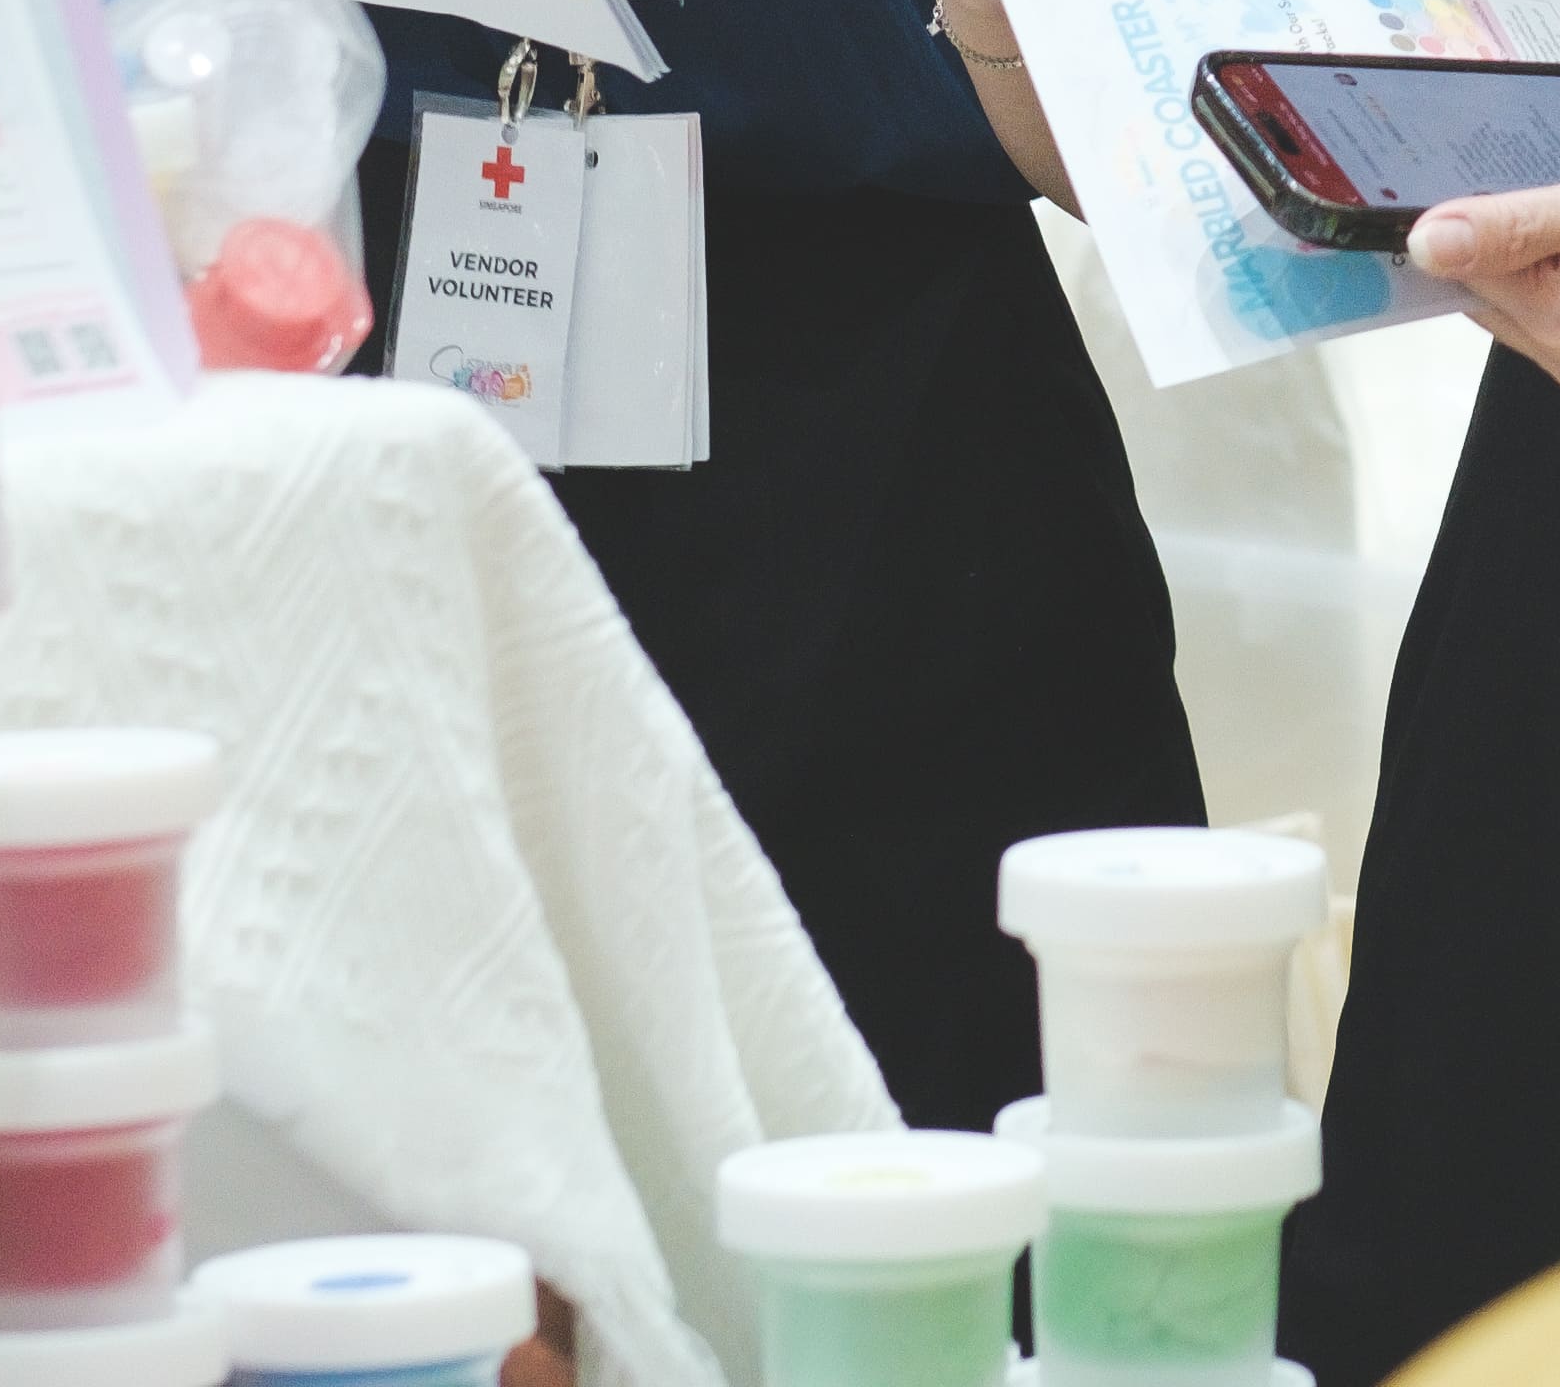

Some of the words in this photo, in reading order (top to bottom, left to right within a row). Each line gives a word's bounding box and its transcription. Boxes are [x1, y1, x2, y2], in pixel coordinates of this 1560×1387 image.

[1180, 157, 1277, 314] MARBLED
[450, 250, 539, 279] VENDOR
[428, 276, 554, 310] VOLUNTEER
